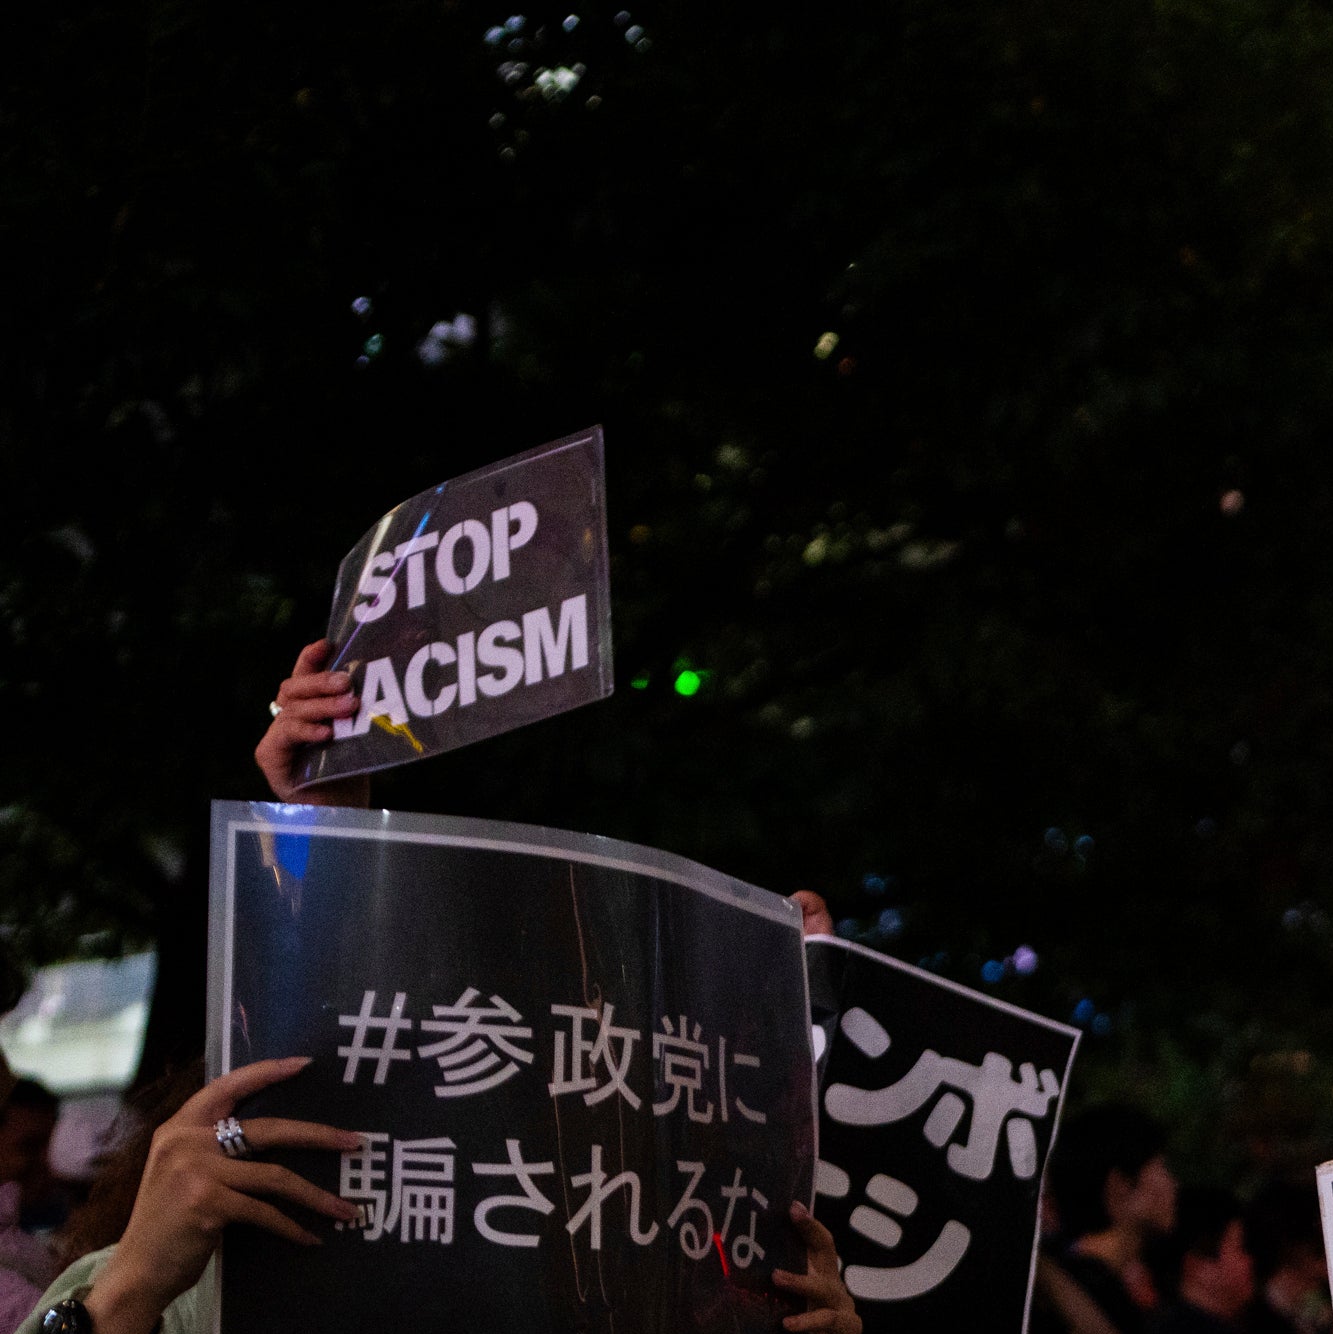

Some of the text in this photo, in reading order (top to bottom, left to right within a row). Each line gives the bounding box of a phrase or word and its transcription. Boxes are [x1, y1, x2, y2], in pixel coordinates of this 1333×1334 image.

[353, 501, 538, 625] STOP
[338, 987, 768, 1125] #参政党に
[335, 1132, 769, 1270] 騙されるな
